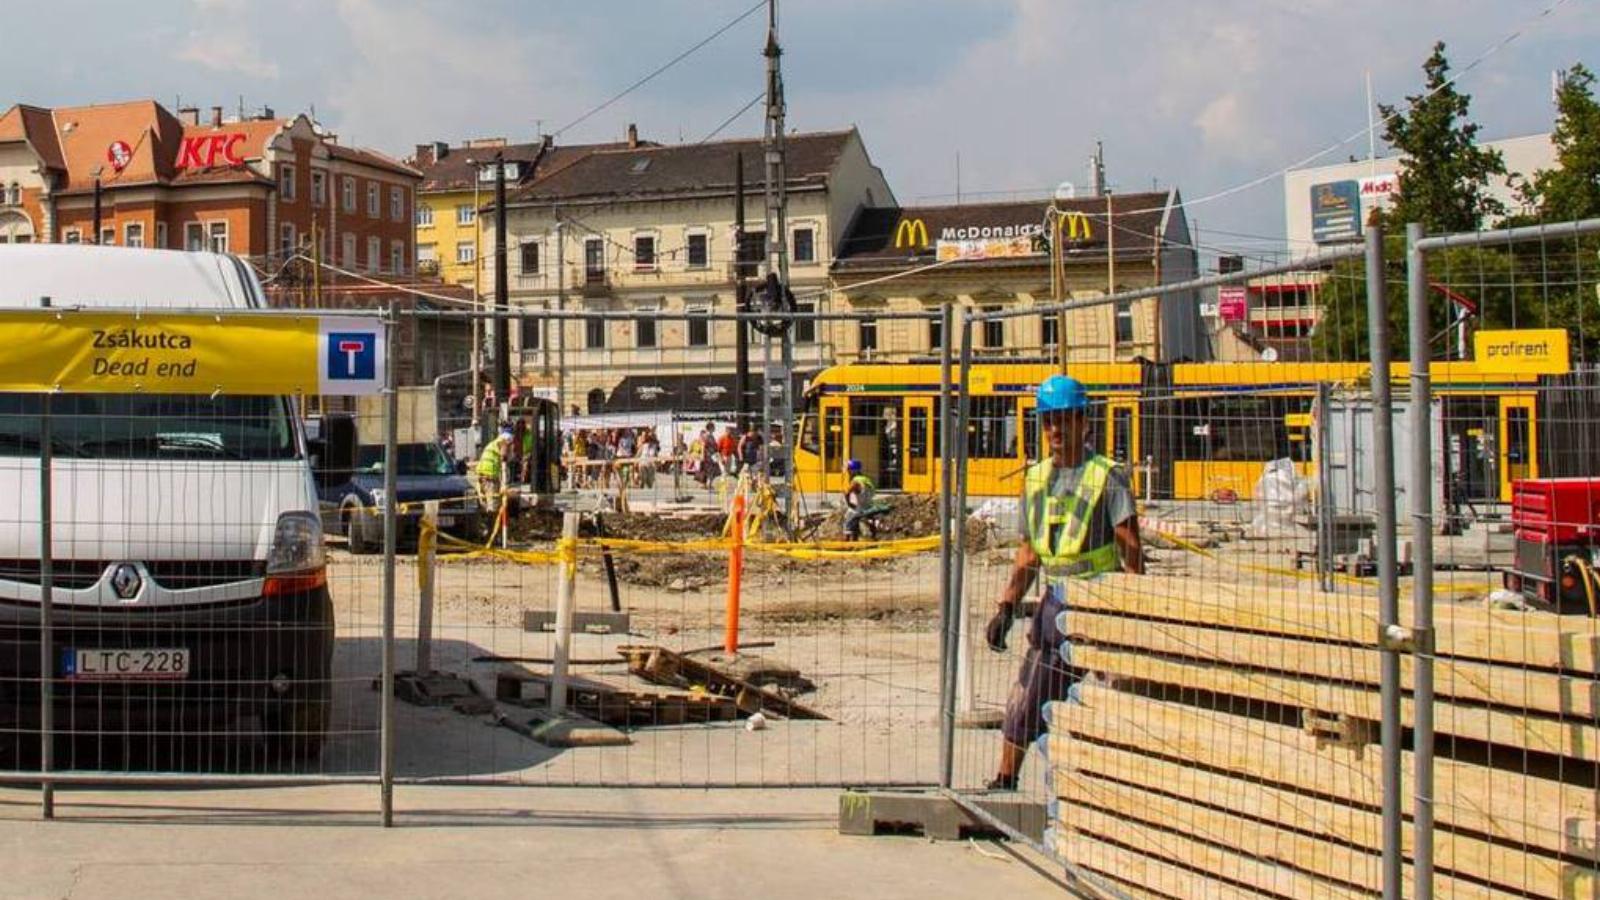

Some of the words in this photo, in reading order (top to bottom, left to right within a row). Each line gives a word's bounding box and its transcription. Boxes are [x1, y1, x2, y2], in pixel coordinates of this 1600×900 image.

[175, 132, 247, 169] KFC
[942, 224, 1043, 240] McDonald's
[92, 329, 192, 349] Zsákutca
[1487, 341, 1549, 360] profirent
[92, 357, 149, 376] Dead
[156, 358, 197, 377] end
[82, 651, 184, 673] LTC-228
